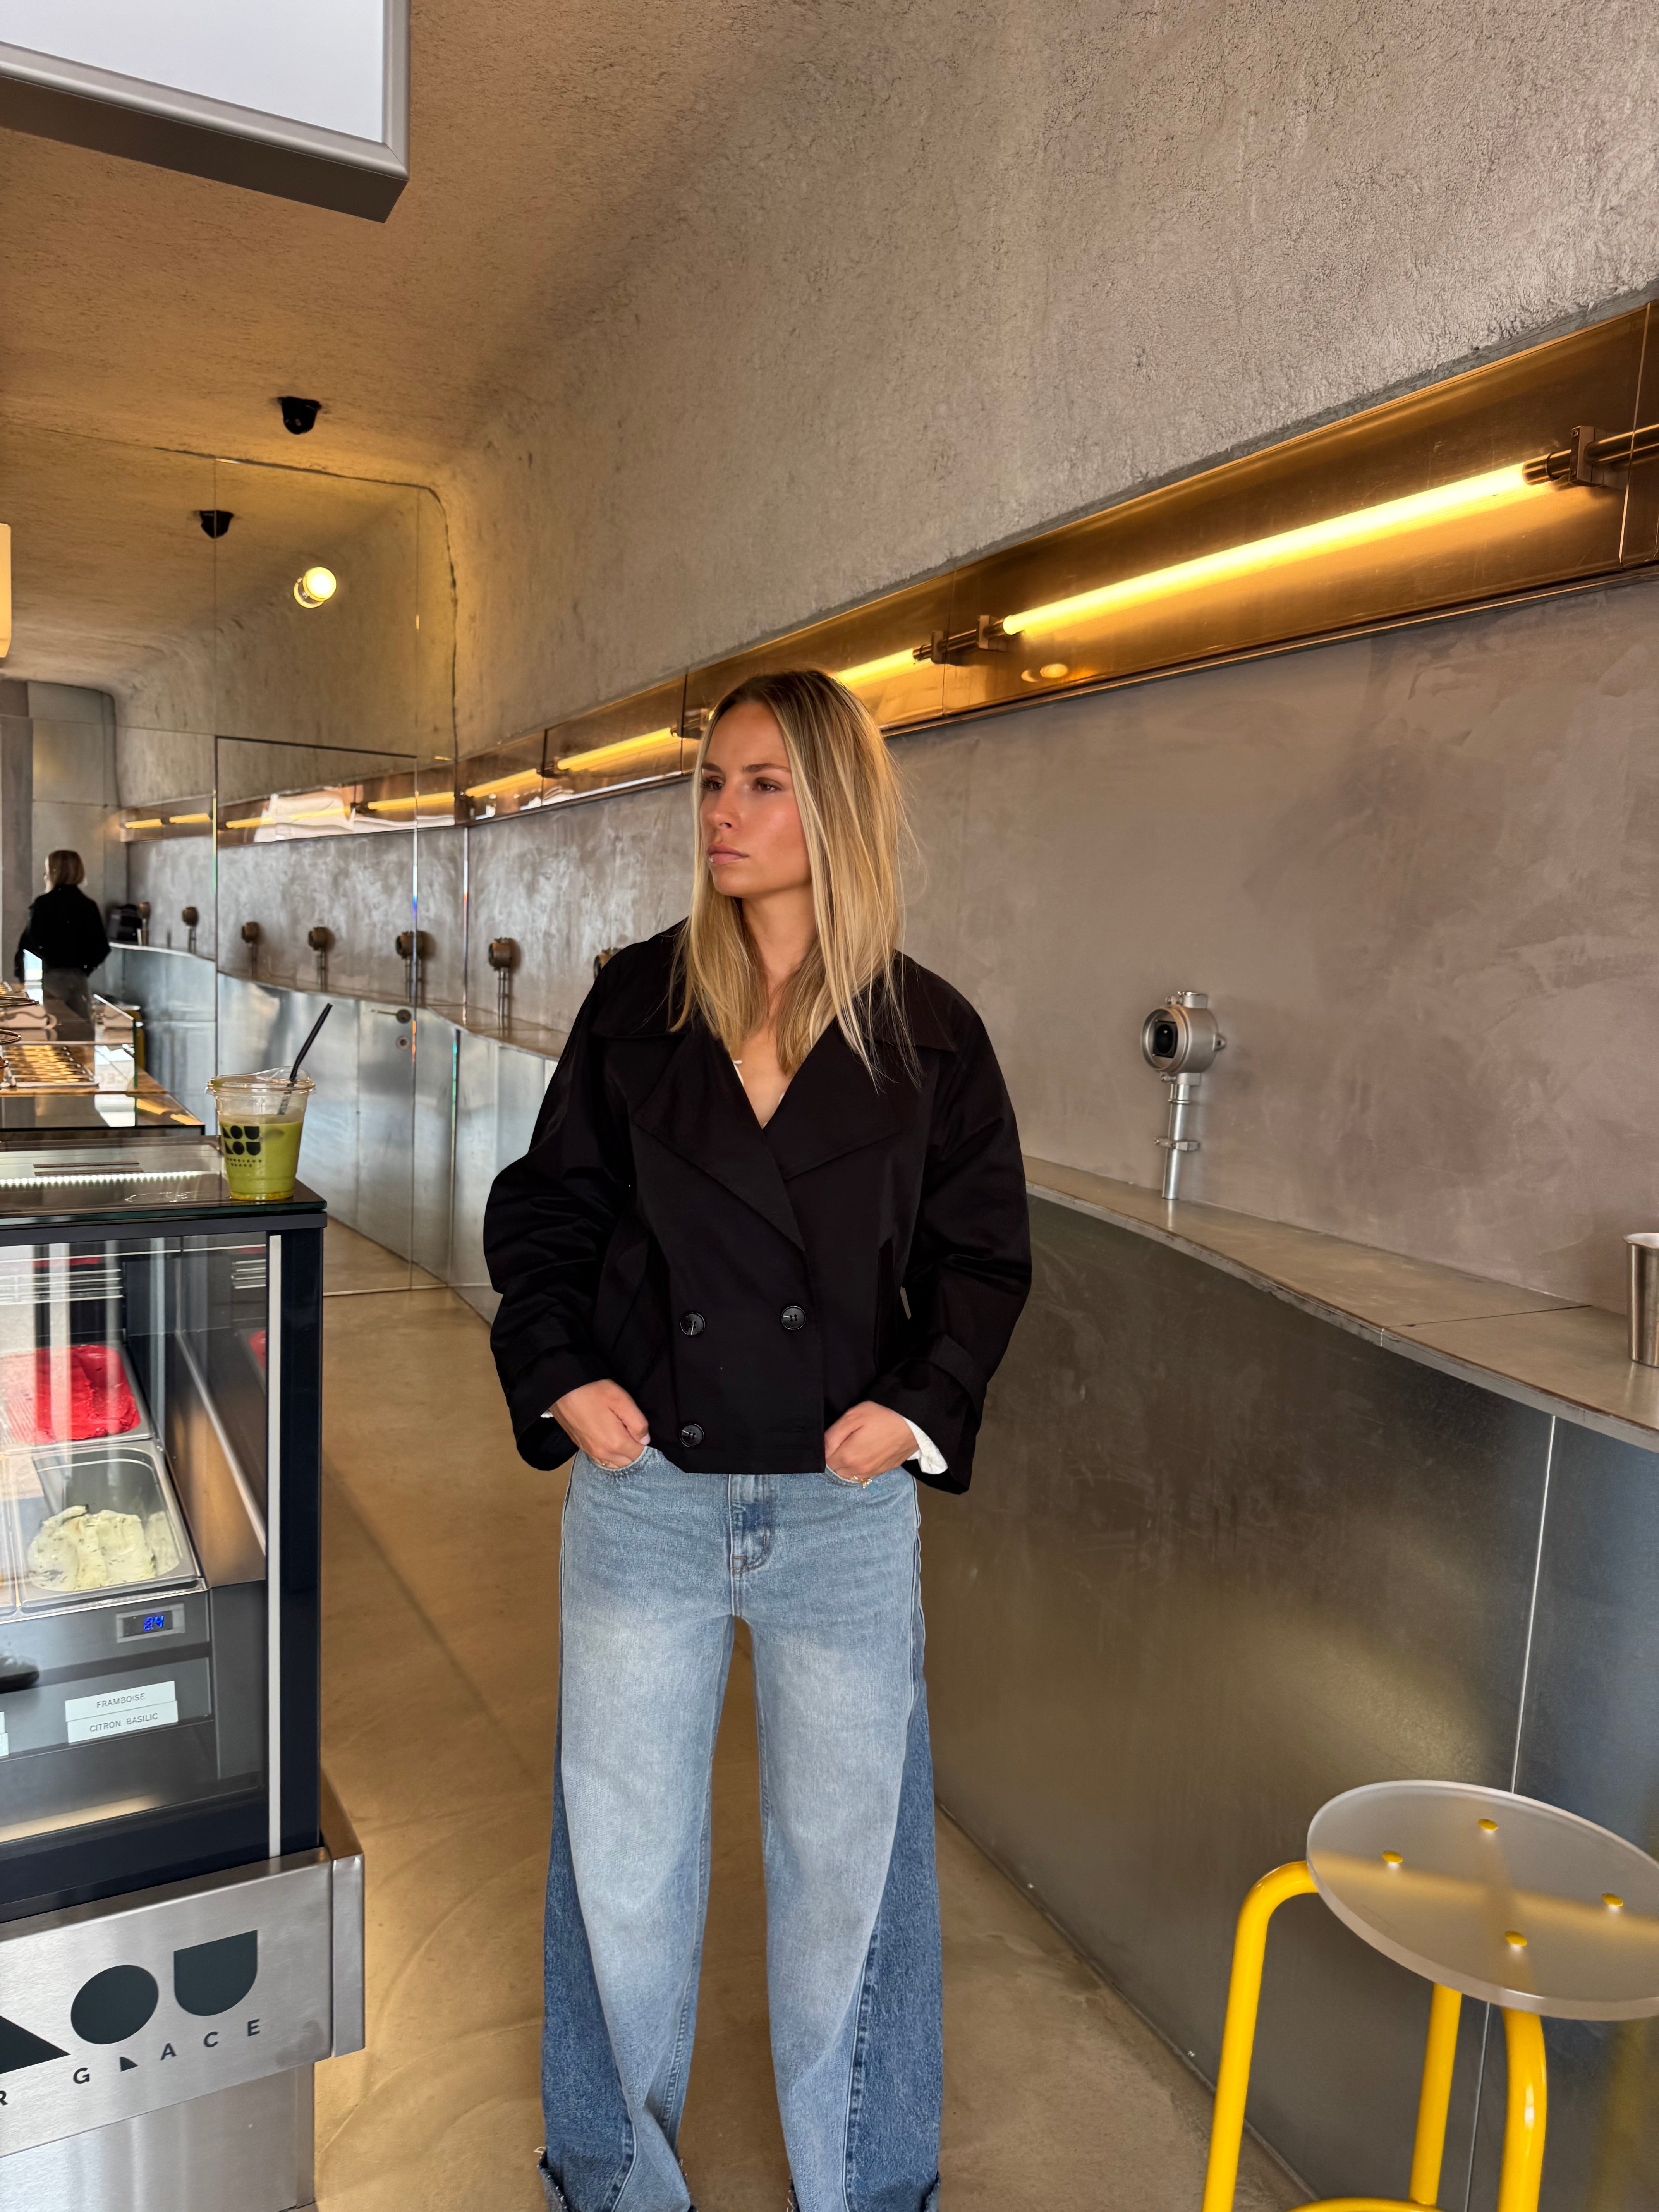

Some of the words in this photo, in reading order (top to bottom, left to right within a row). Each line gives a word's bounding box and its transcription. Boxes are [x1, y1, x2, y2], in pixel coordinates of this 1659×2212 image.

[96, 1693, 146, 1709] FRAMBOISE
[89, 1720, 121, 1732] CITRON
[126, 1713, 158, 1725] BASILIC
